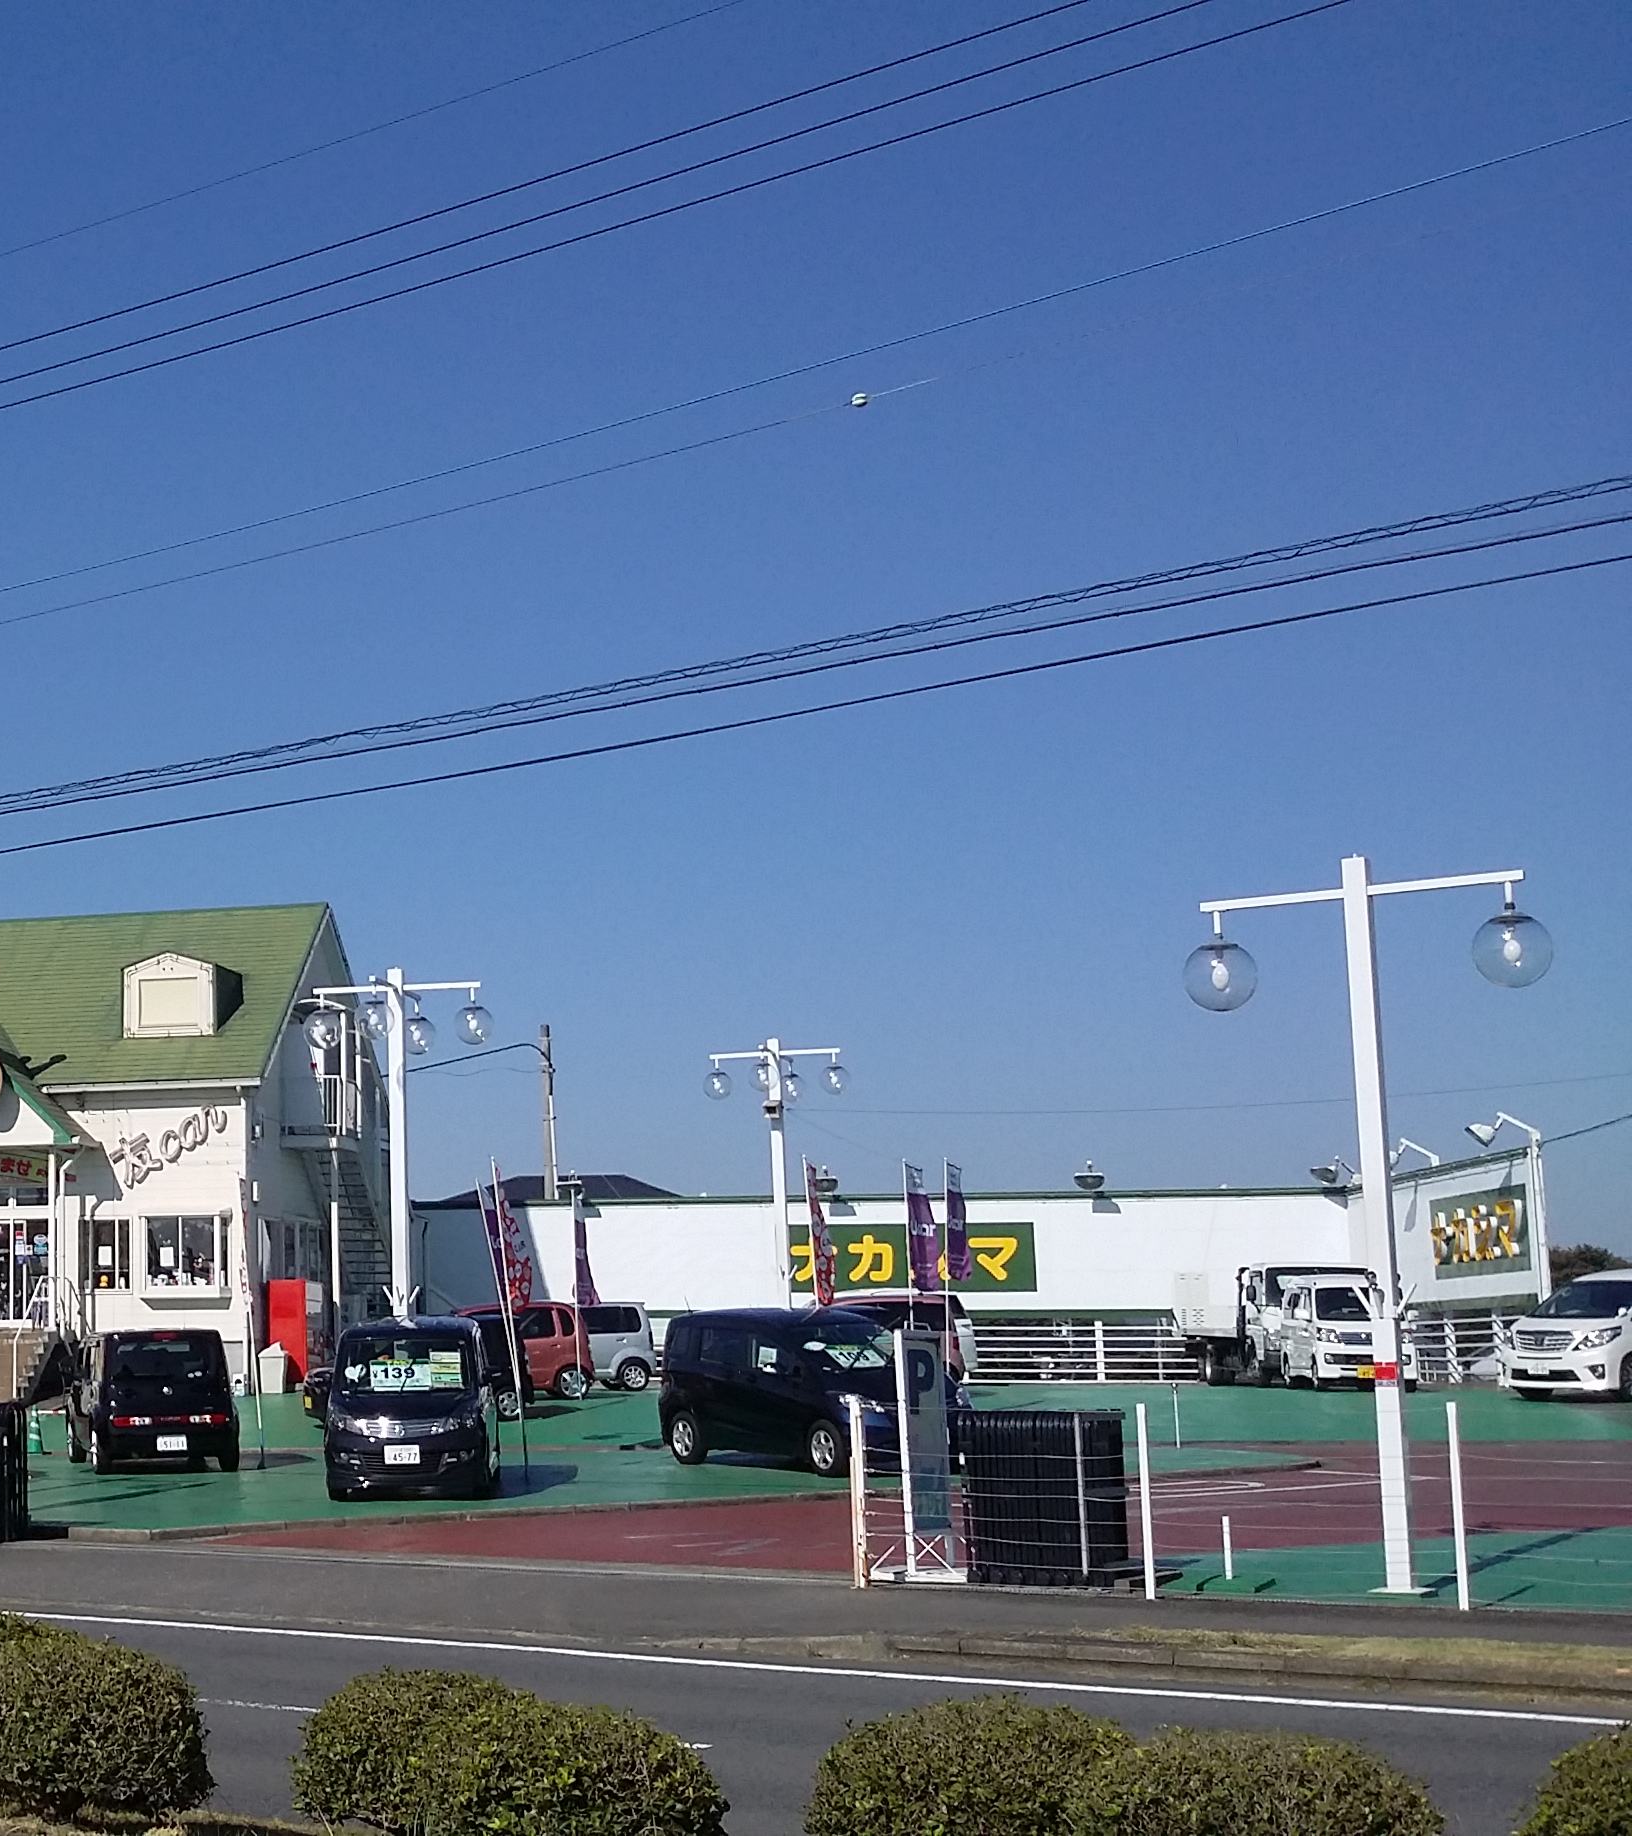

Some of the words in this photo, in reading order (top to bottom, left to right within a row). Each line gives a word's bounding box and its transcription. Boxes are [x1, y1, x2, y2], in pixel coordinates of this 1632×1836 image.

[790, 1234, 1019, 1283] ナカマ
[906, 1347, 935, 1415] P
